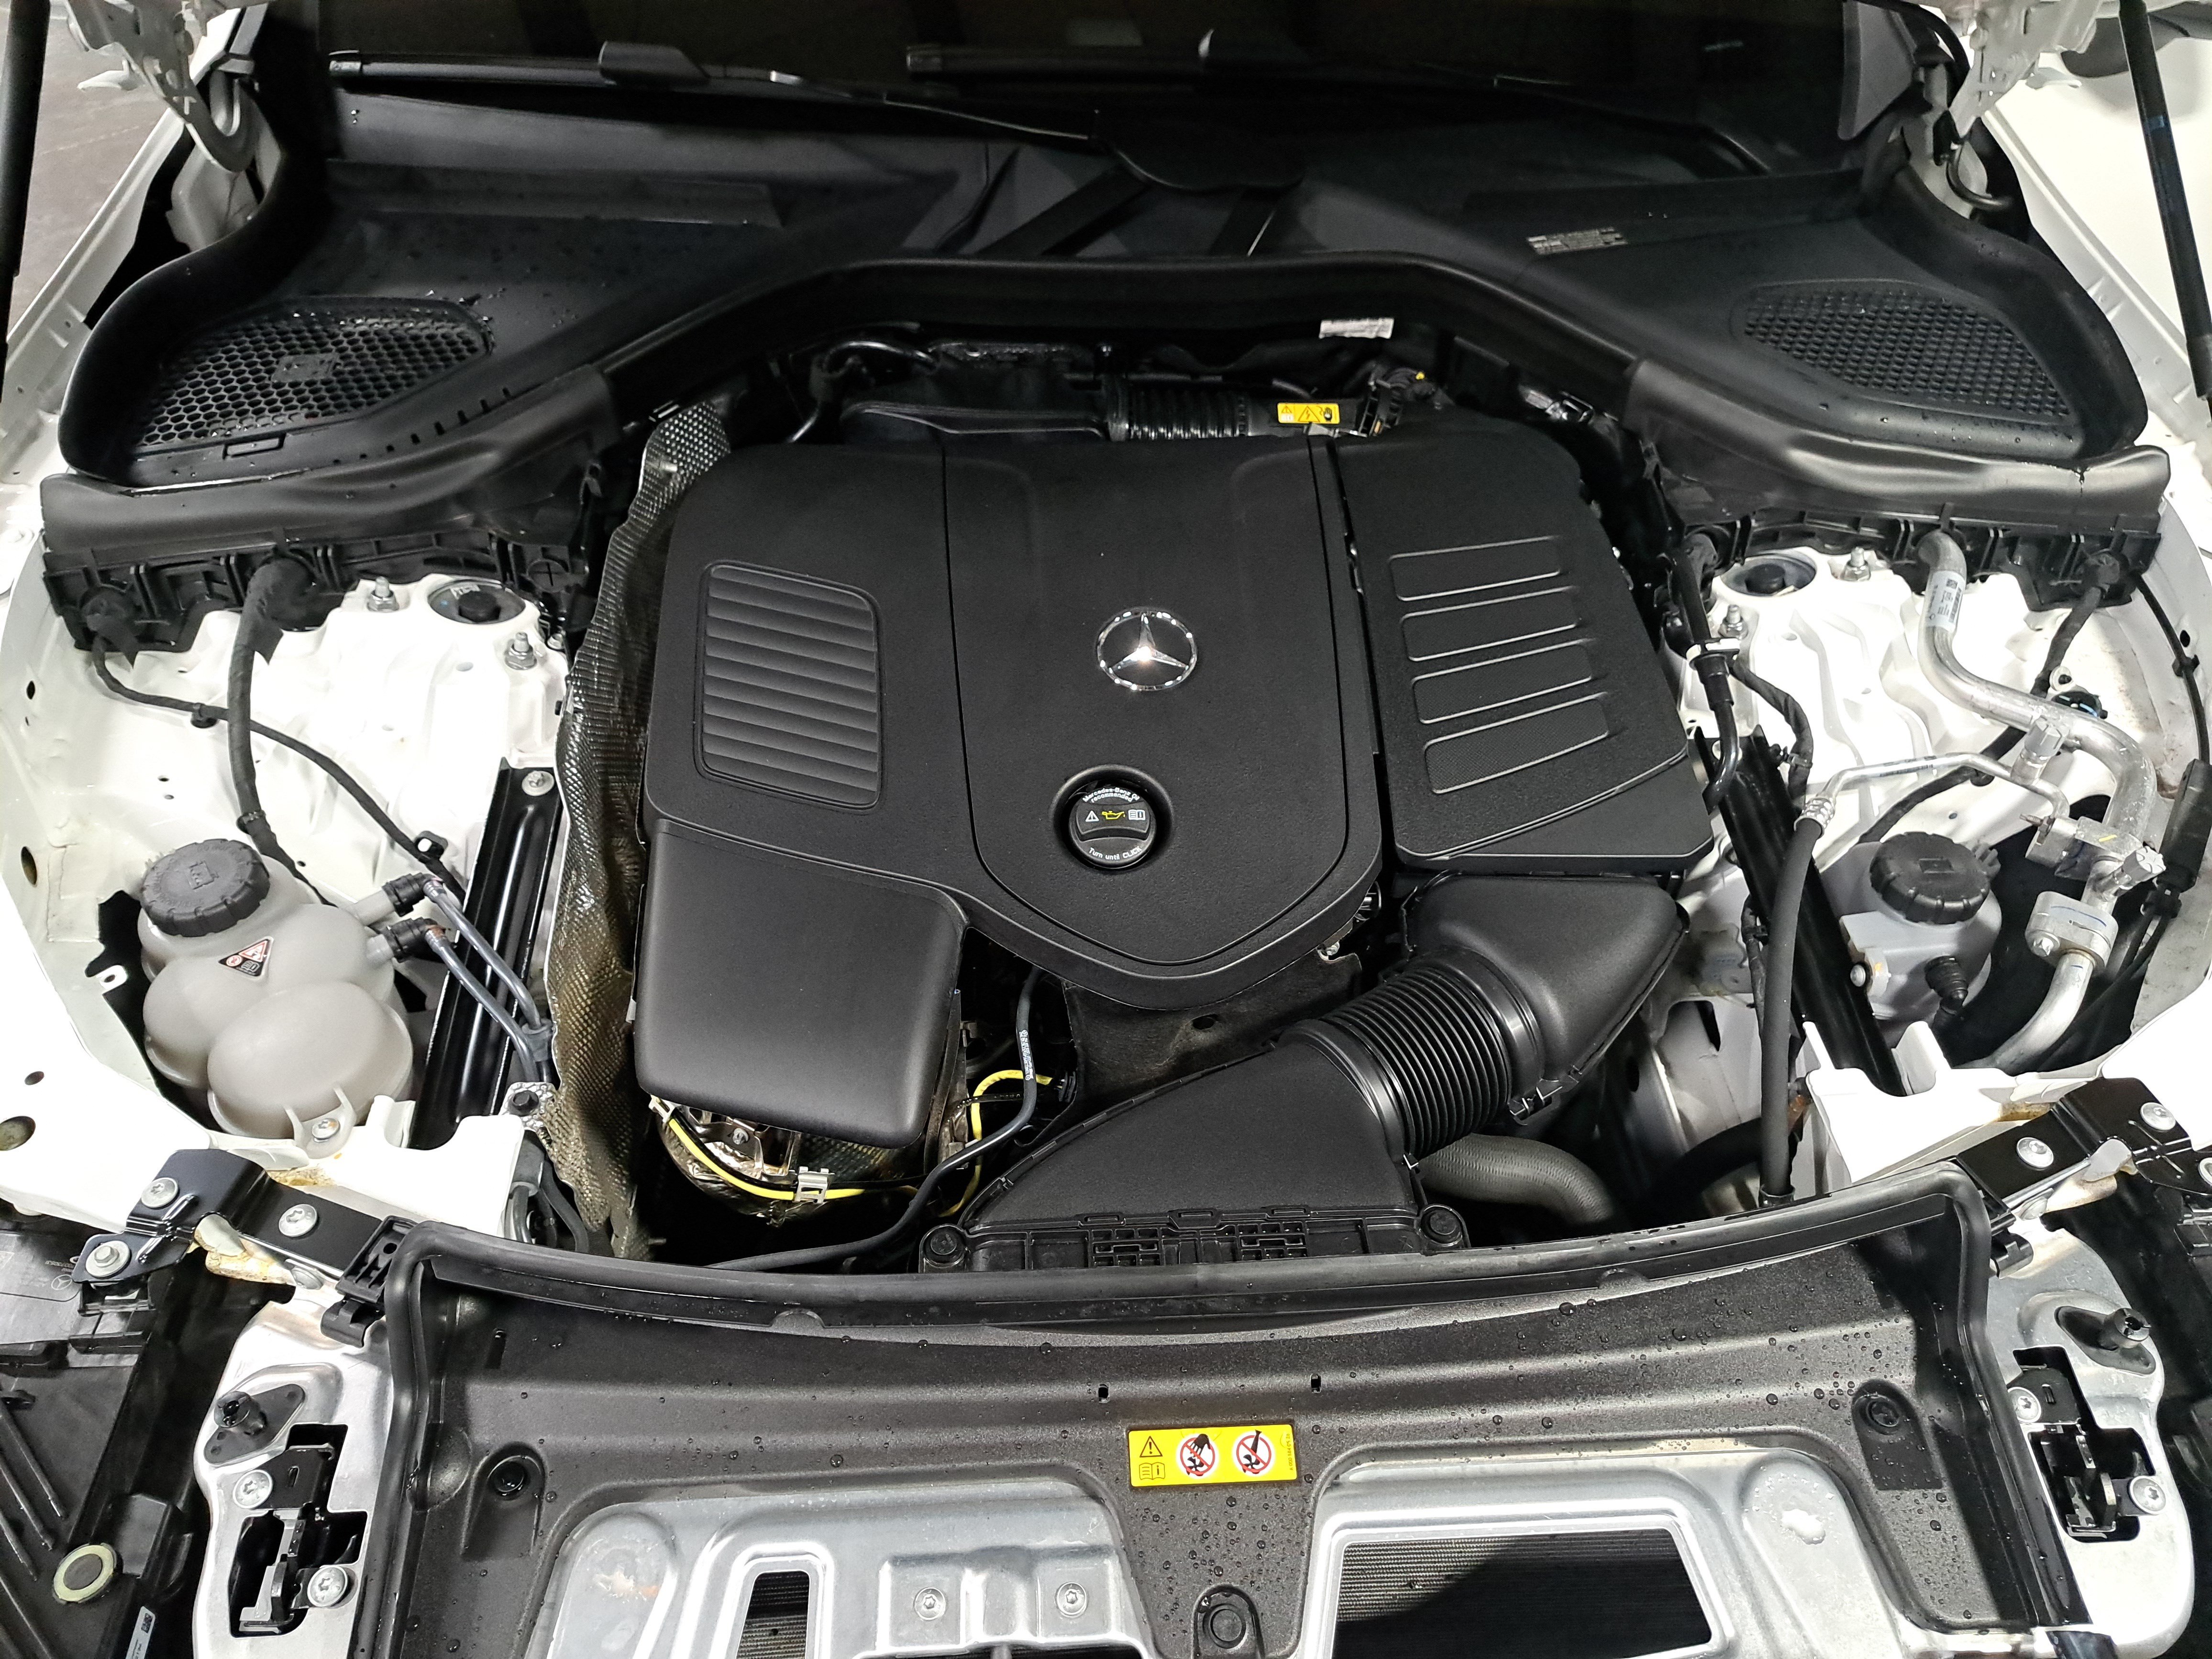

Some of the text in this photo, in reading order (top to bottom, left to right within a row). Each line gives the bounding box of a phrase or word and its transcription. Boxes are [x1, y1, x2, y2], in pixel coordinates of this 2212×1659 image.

[1083, 787, 1131, 802] Mercedes-Benz
[1091, 793, 1133, 803] recommended
[1089, 847, 1103, 858] Turn
[1122, 845, 1142, 858] CLICK
